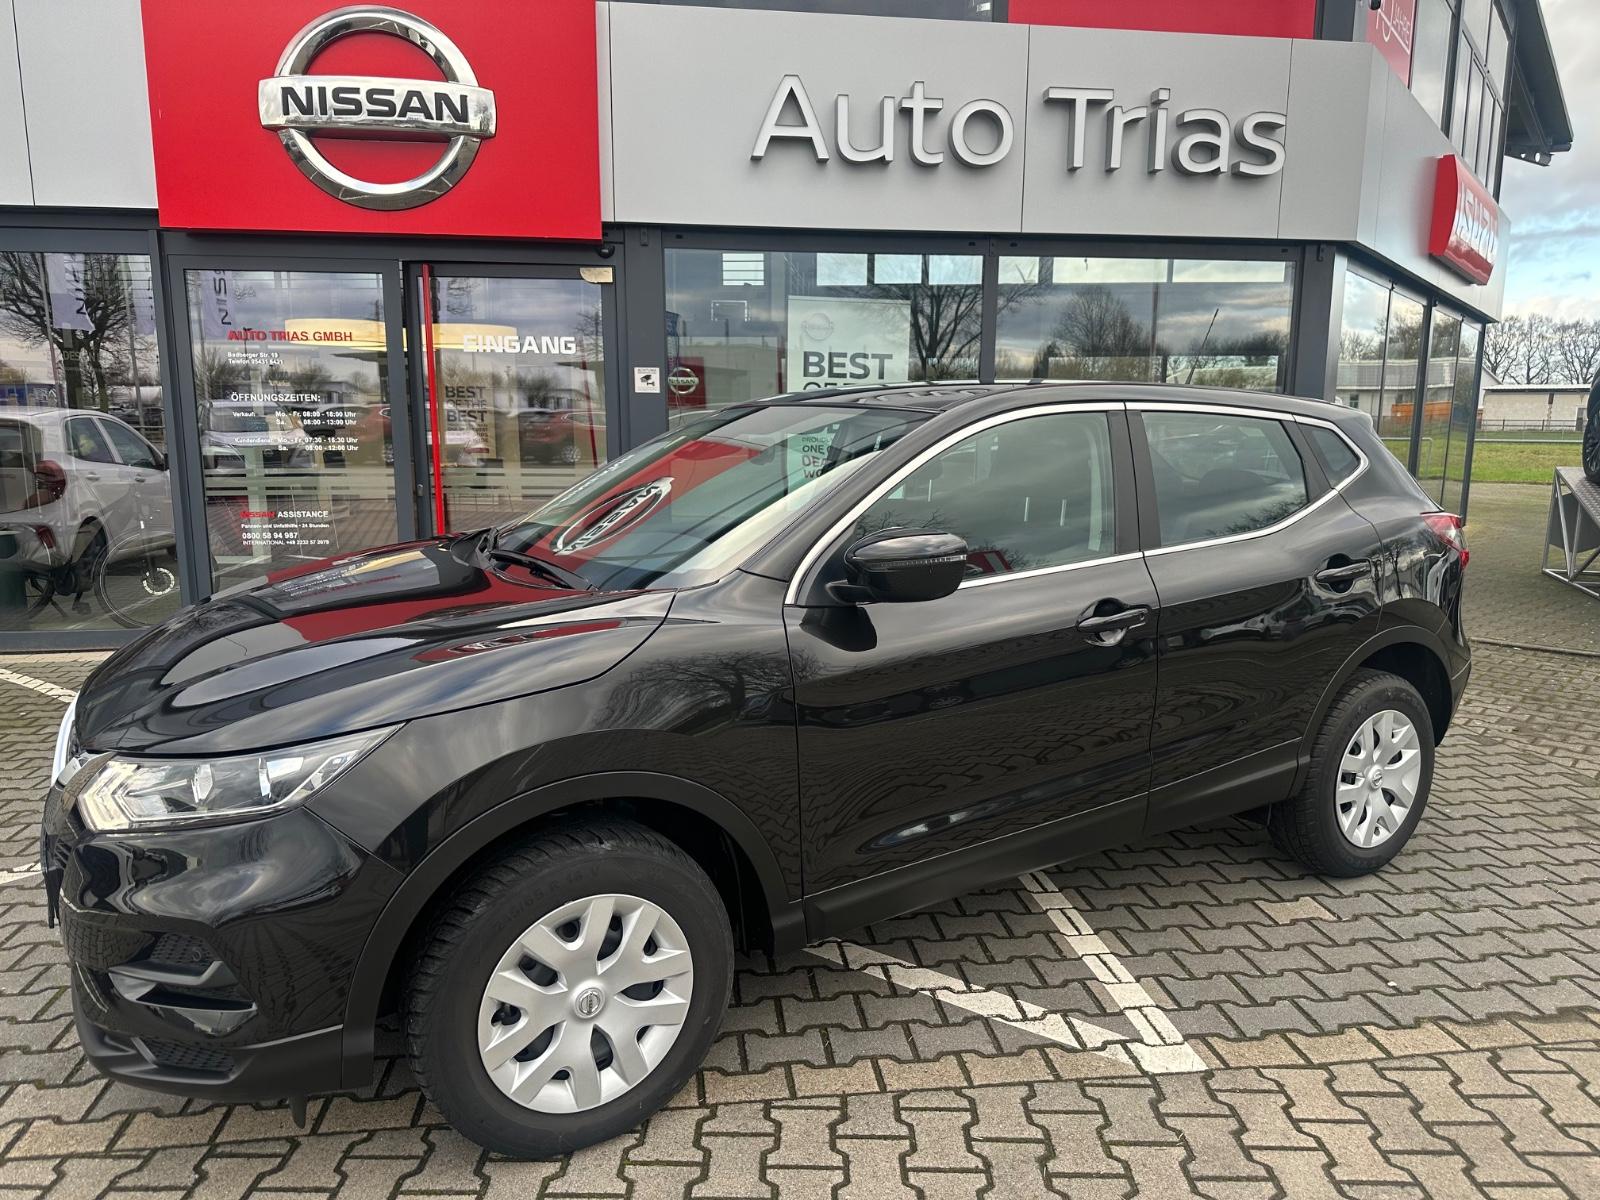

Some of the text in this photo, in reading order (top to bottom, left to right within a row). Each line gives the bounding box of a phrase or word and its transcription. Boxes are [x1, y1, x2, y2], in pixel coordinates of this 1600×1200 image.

[281, 86, 470, 123] NISSAN
[750, 74, 1287, 175] Auto Trias
[1454, 179, 1499, 266] ISUZU
[228, 330, 353, 342] AUTO TRIAS GMBH
[463, 335, 577, 355] EINGANG
[803, 351, 893, 380] BEST
[231, 391, 321, 402] ÖFFNUNGSZEITEN:
[445, 385, 486, 399] BEST
[446, 409, 488, 422] BEST
[802, 445, 825, 454] ONE
[277, 510, 329, 518] ASSISTANCE
[241, 532, 261, 540] 0800
